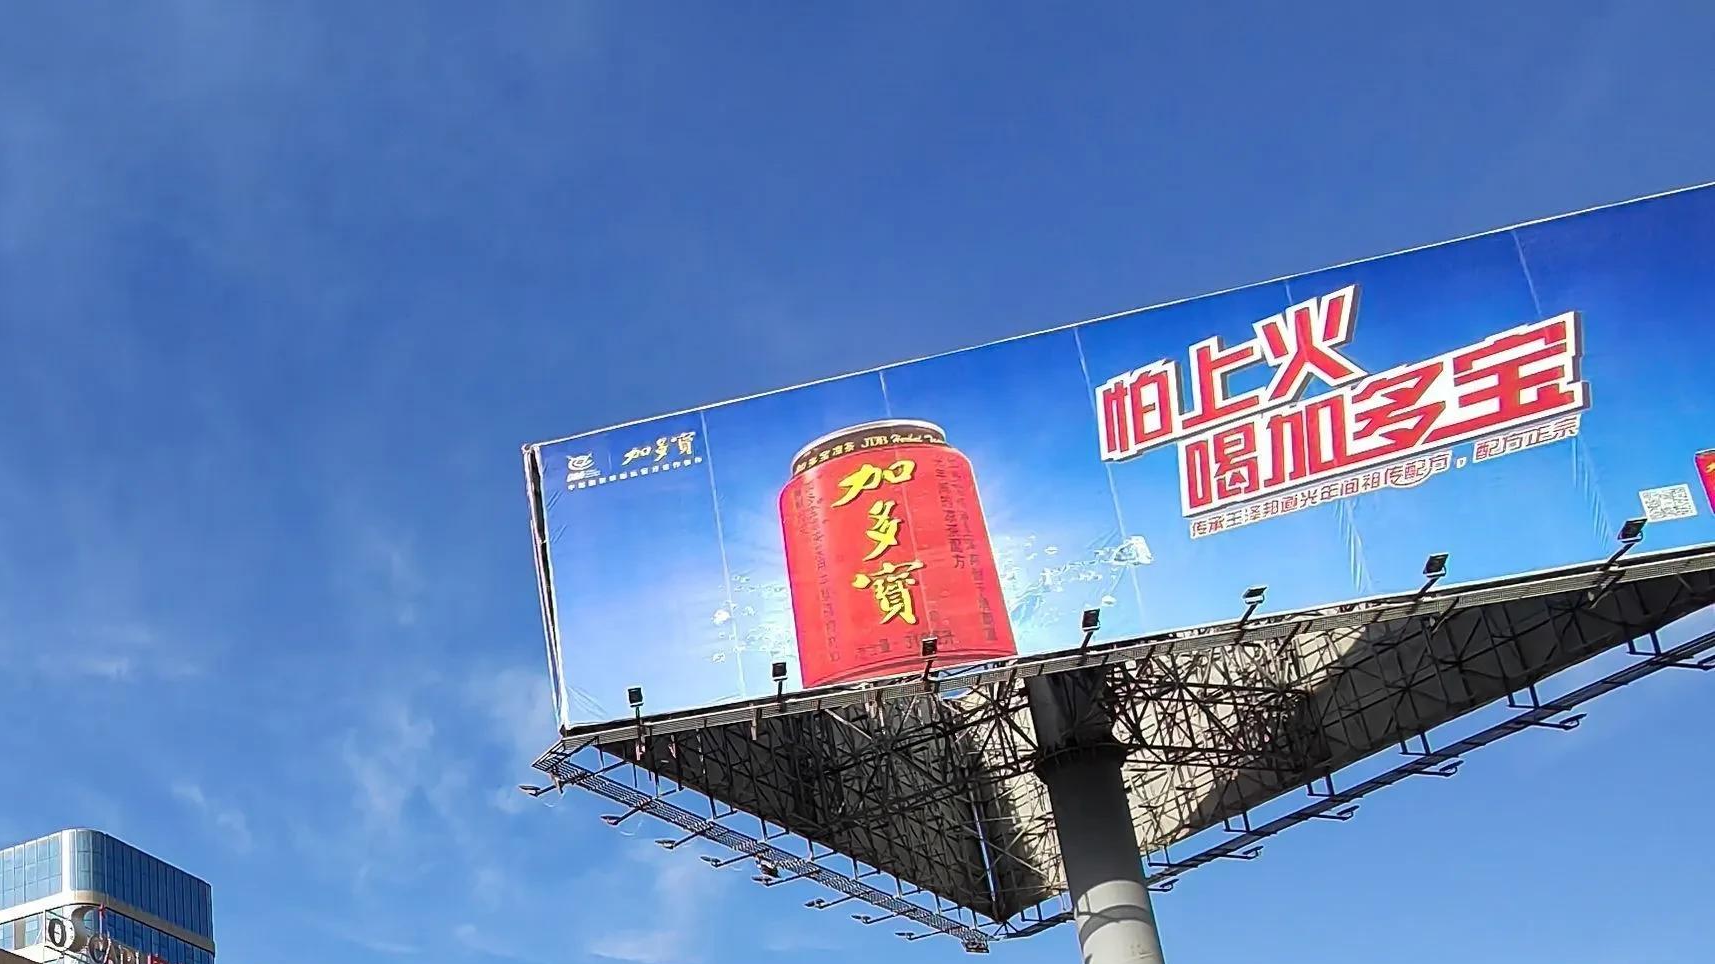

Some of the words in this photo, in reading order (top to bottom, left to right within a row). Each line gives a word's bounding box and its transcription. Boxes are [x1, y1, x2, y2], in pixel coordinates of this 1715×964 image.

[1099, 290, 1361, 458] 怕上火
[1183, 316, 1582, 512] 喝加多宝
